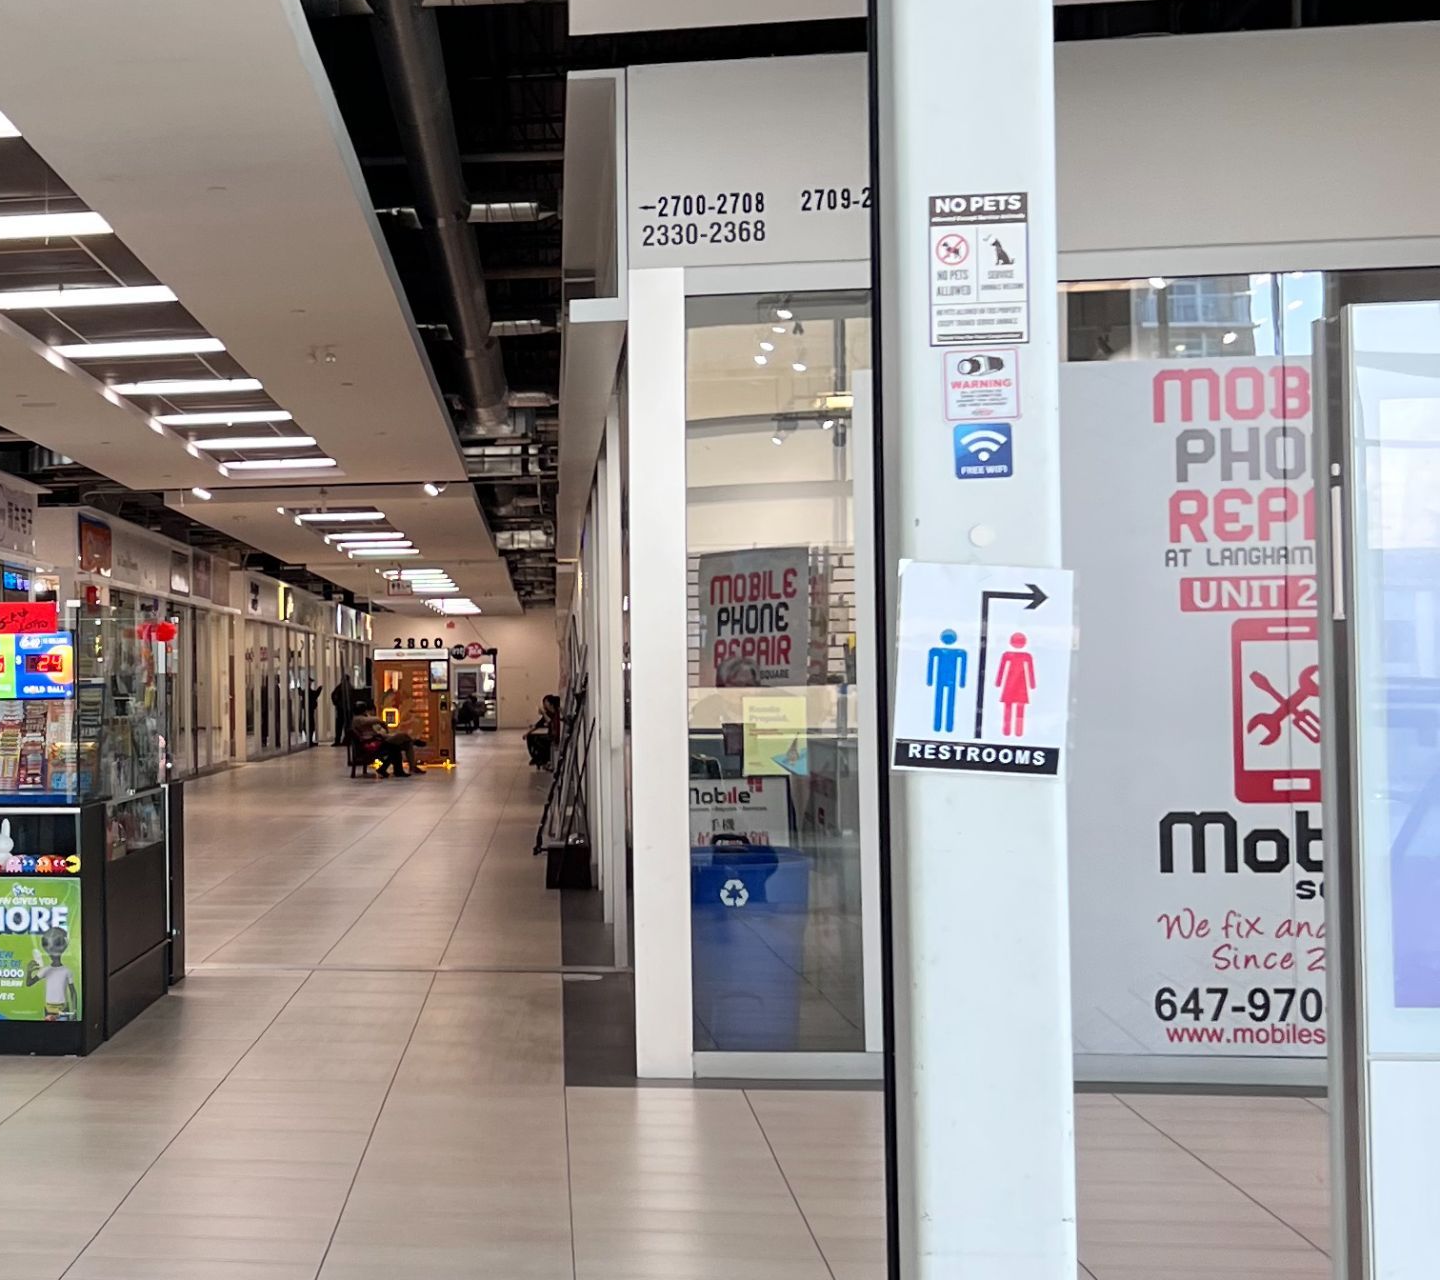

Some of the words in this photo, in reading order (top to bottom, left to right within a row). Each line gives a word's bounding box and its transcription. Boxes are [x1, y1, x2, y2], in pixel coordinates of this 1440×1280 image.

[658, 192, 765, 217] 2700-2708
[935, 197, 967, 214] NO
[970, 195, 1022, 212] PETS
[642, 220, 766, 247] 2330-2368
[950, 378, 1013, 390] WARNING
[1153, 366, 1311, 423] MOB
[1176, 426, 1314, 482] PHO
[960, 465, 985, 475] FREE
[1165, 548, 1192, 567] AT
[1206, 546, 1314, 567] LANGHAM
[710, 568, 798, 606] MOBILE
[1192, 579, 1286, 609] UNIT
[717, 602, 790, 637] PHONE
[394, 638, 443, 649] 2800
[23, 685, 46, 695] GOLD
[908, 743, 1047, 766] RESTROOMS
[12, 897, 38, 906] GIVES
[39, 897, 58, 906] YOU
[1157, 908, 1210, 939] We
[1221, 910, 1264, 939] fix
[1212, 943, 1295, 971] Since
[1155, 986, 1323, 1022] 647-970
